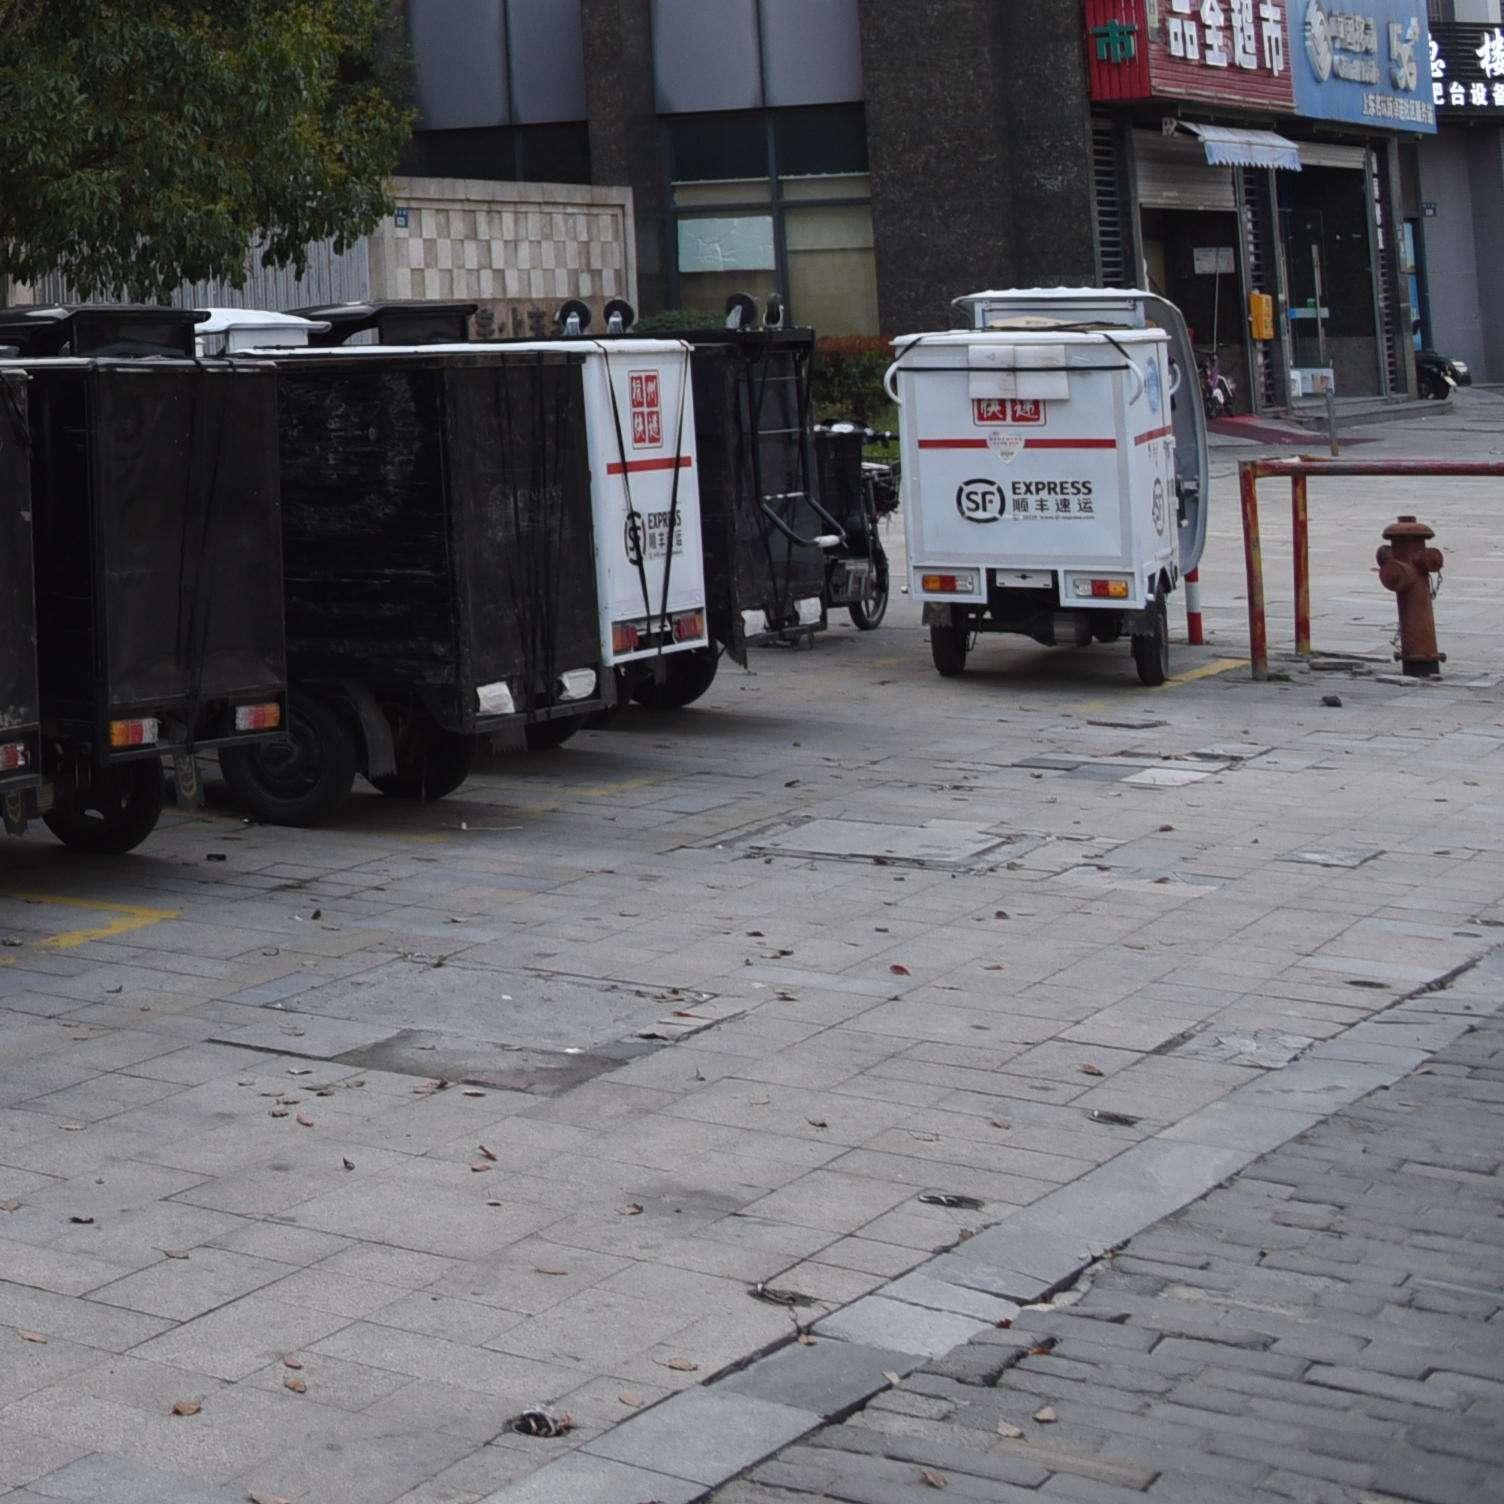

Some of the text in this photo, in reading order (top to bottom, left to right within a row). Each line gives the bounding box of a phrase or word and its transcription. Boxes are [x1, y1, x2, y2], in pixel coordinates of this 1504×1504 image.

[1011, 480, 1093, 496] EXPRESS
[965, 490, 996, 513] SF
[1012, 497, 1094, 514] 顺丰速运
